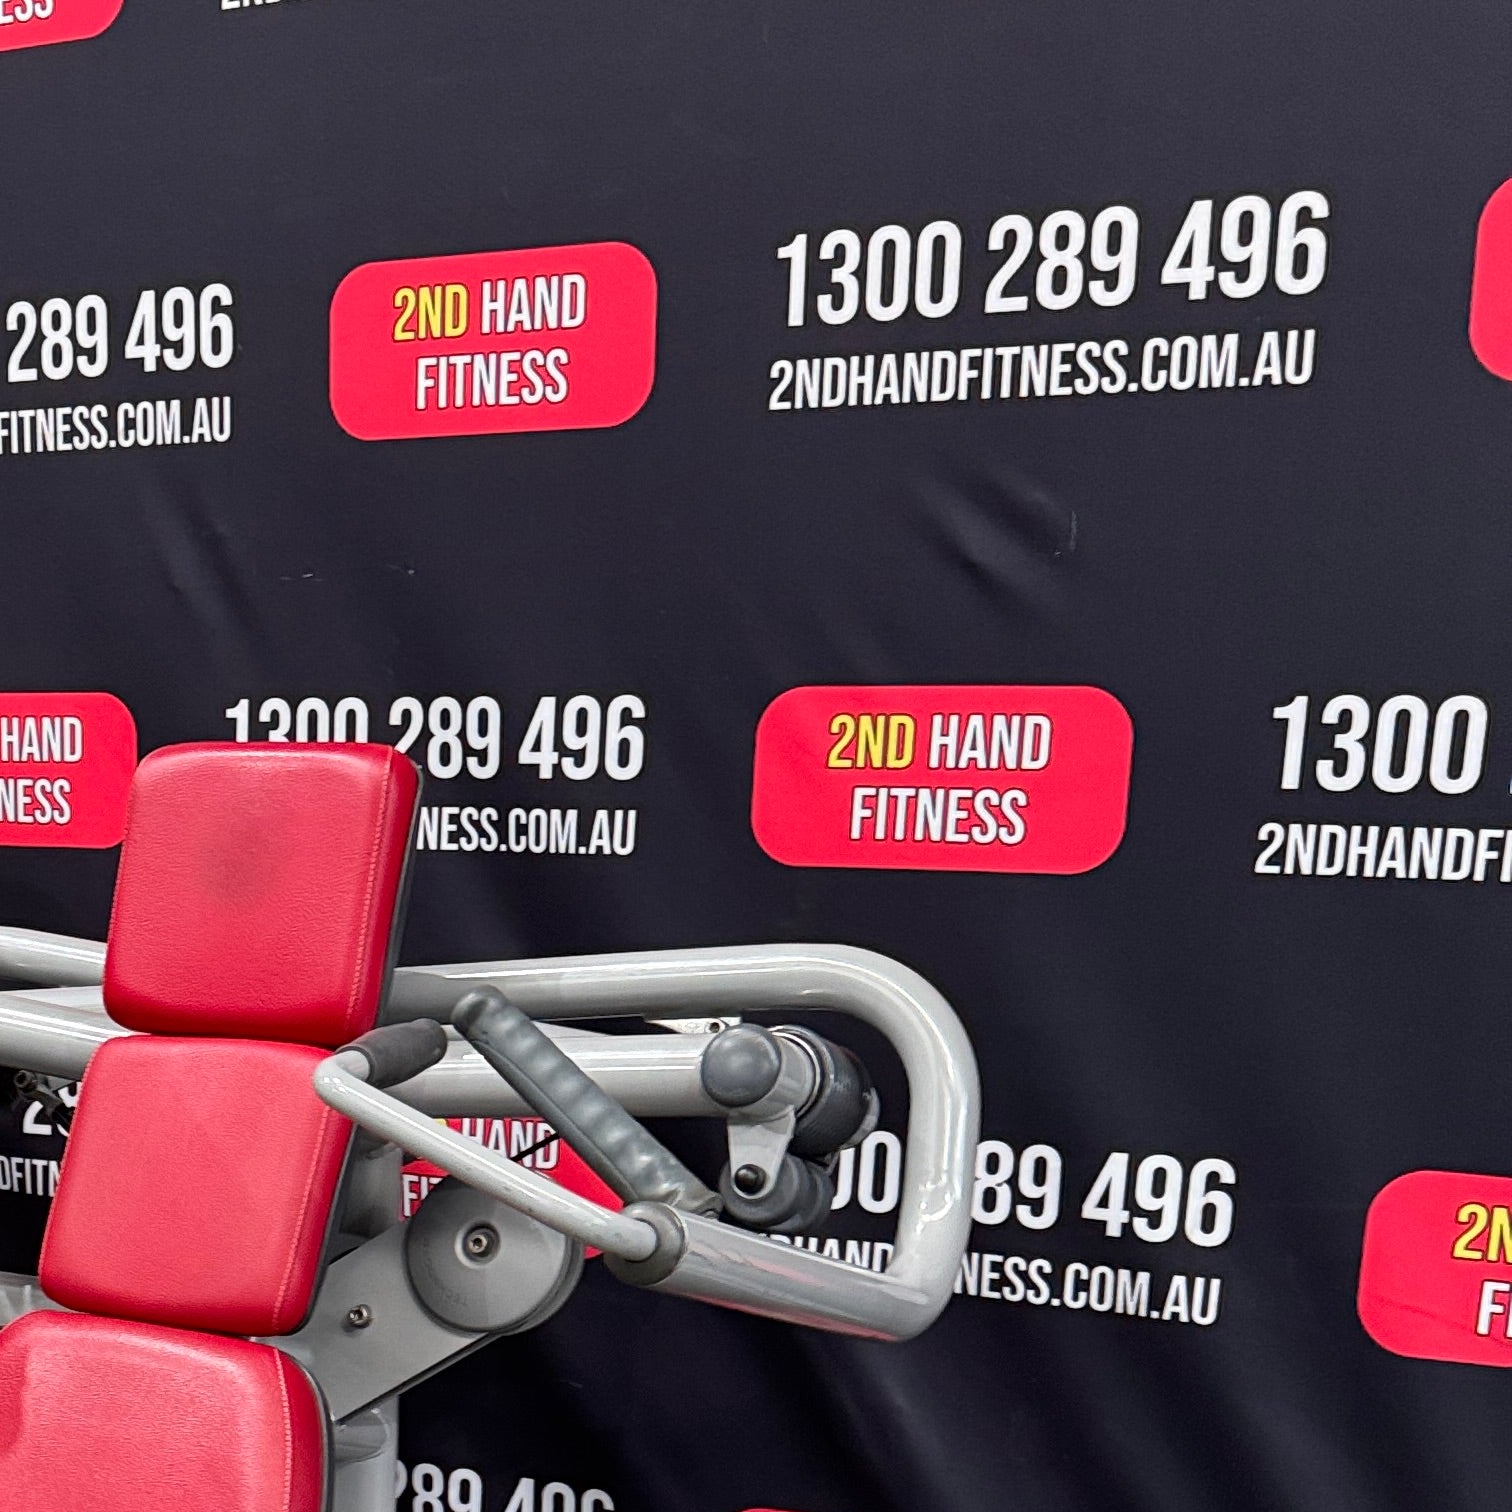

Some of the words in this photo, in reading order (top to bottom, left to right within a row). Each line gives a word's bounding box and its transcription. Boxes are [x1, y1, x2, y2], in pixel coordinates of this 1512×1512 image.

[778, 221, 961, 326] 1300
[985, 206, 1138, 313] 289
[1161, 191, 1329, 300] 496
[6, 295, 108, 382] 289
[125, 283, 233, 372] 496
[395, 285, 467, 340] 2ND
[483, 275, 585, 333] HAND
[418, 349, 567, 408] FITNESS
[769, 329, 1315, 410] 2NDHANDFITNESS.COM.AU
[2, 717, 81, 761] HAND
[389, 696, 500, 779] 289
[519, 695, 645, 780] 496
[829, 715, 914, 767] 2ND
[930, 715, 1050, 769] HAND
[1273, 695, 1487, 794] 1300
[852, 788, 1026, 843] FITNESS
[969, 1141, 1063, 1230] 89
[1082, 1152, 1235, 1247] 496
[1453, 1203, 1512, 1264] 2N
